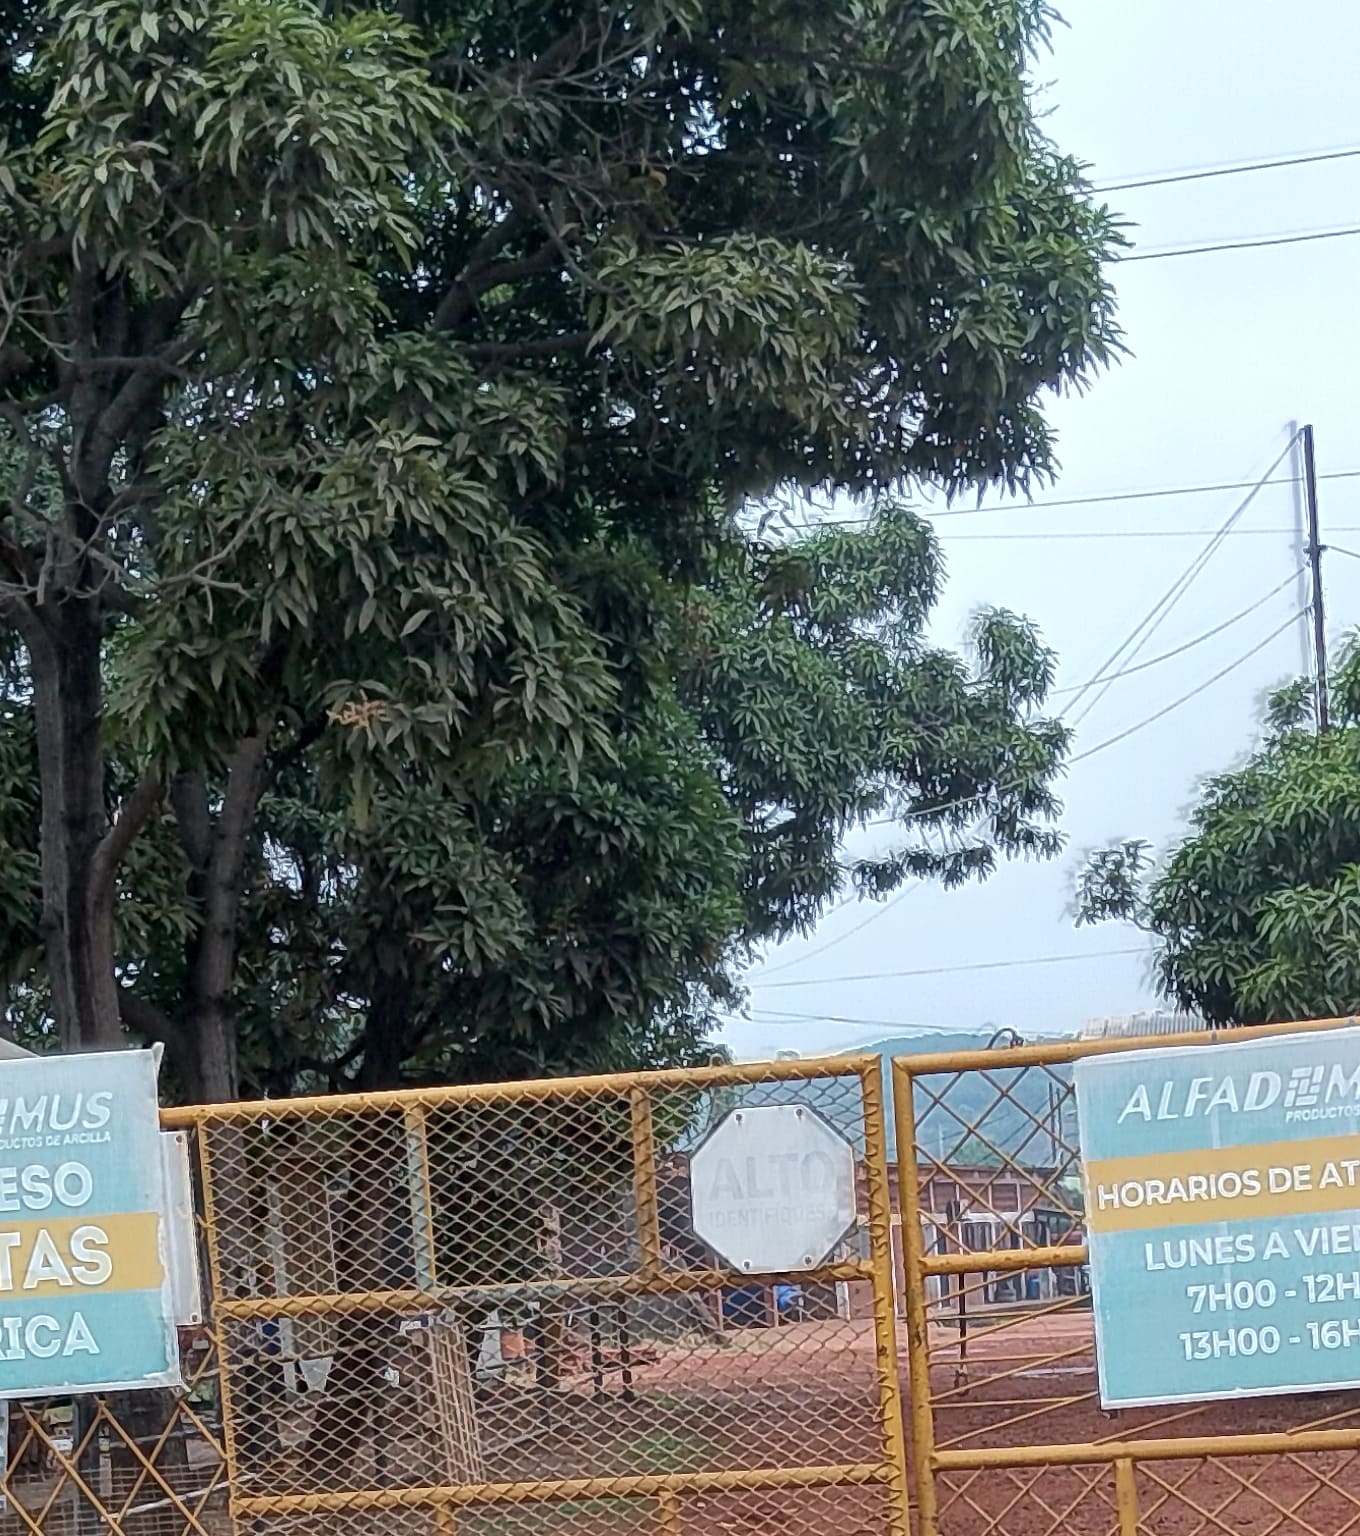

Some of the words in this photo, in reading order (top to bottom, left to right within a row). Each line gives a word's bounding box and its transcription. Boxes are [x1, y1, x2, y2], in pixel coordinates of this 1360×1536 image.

[1285, 1104, 1360, 1123] PRODUCTOS
[45, 1134, 60, 1146] DE
[63, 1131, 111, 1145] ARCILLA
[709, 1151, 835, 1201] ALTO
[1097, 1168, 1260, 1210] HORARIOS
[1268, 1164, 1312, 1194] DE
[1145, 1233, 1255, 1271] LUNES
[1262, 1231, 1290, 1260] A
[1186, 1278, 1277, 1313] 7H00
[1179, 1326, 1281, 1361] 13H00
